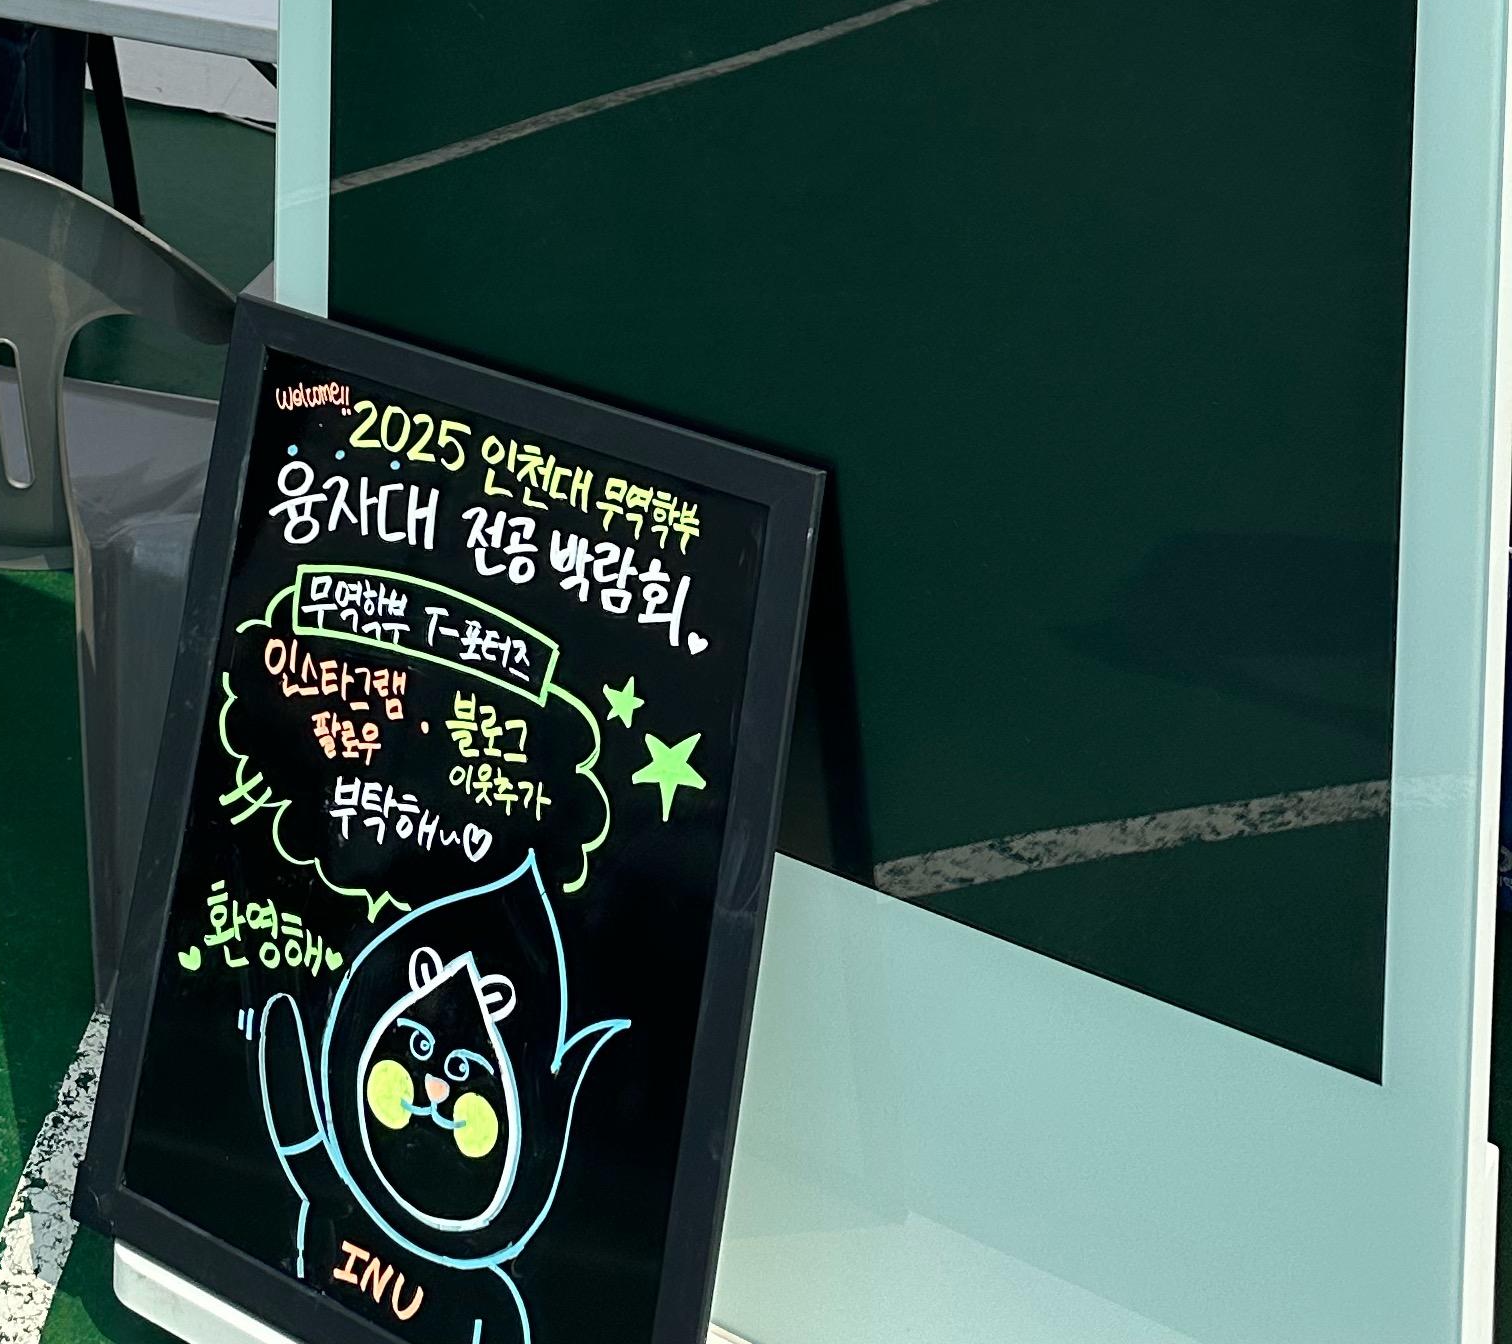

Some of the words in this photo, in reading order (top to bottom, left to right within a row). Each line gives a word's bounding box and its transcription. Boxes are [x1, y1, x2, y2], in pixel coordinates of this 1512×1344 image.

[349, 400, 472, 472] 2025
[480, 435, 594, 514] 인천대
[595, 476, 701, 556] 무역학부
[268, 459, 440, 552] 융자대
[461, 506, 540, 585] 전공
[548, 529, 692, 647] 박람회
[300, 575, 411, 646] 무역학부
[423, 606, 532, 682] T-포터즈
[264, 638, 408, 721] 인스타그램
[311, 710, 382, 766] 팔로우
[445, 689, 529, 764] 블로그
[448, 763, 553, 822] 이웃추가
[203, 879, 324, 978] 환영해
[332, 1239, 425, 1322] INU
